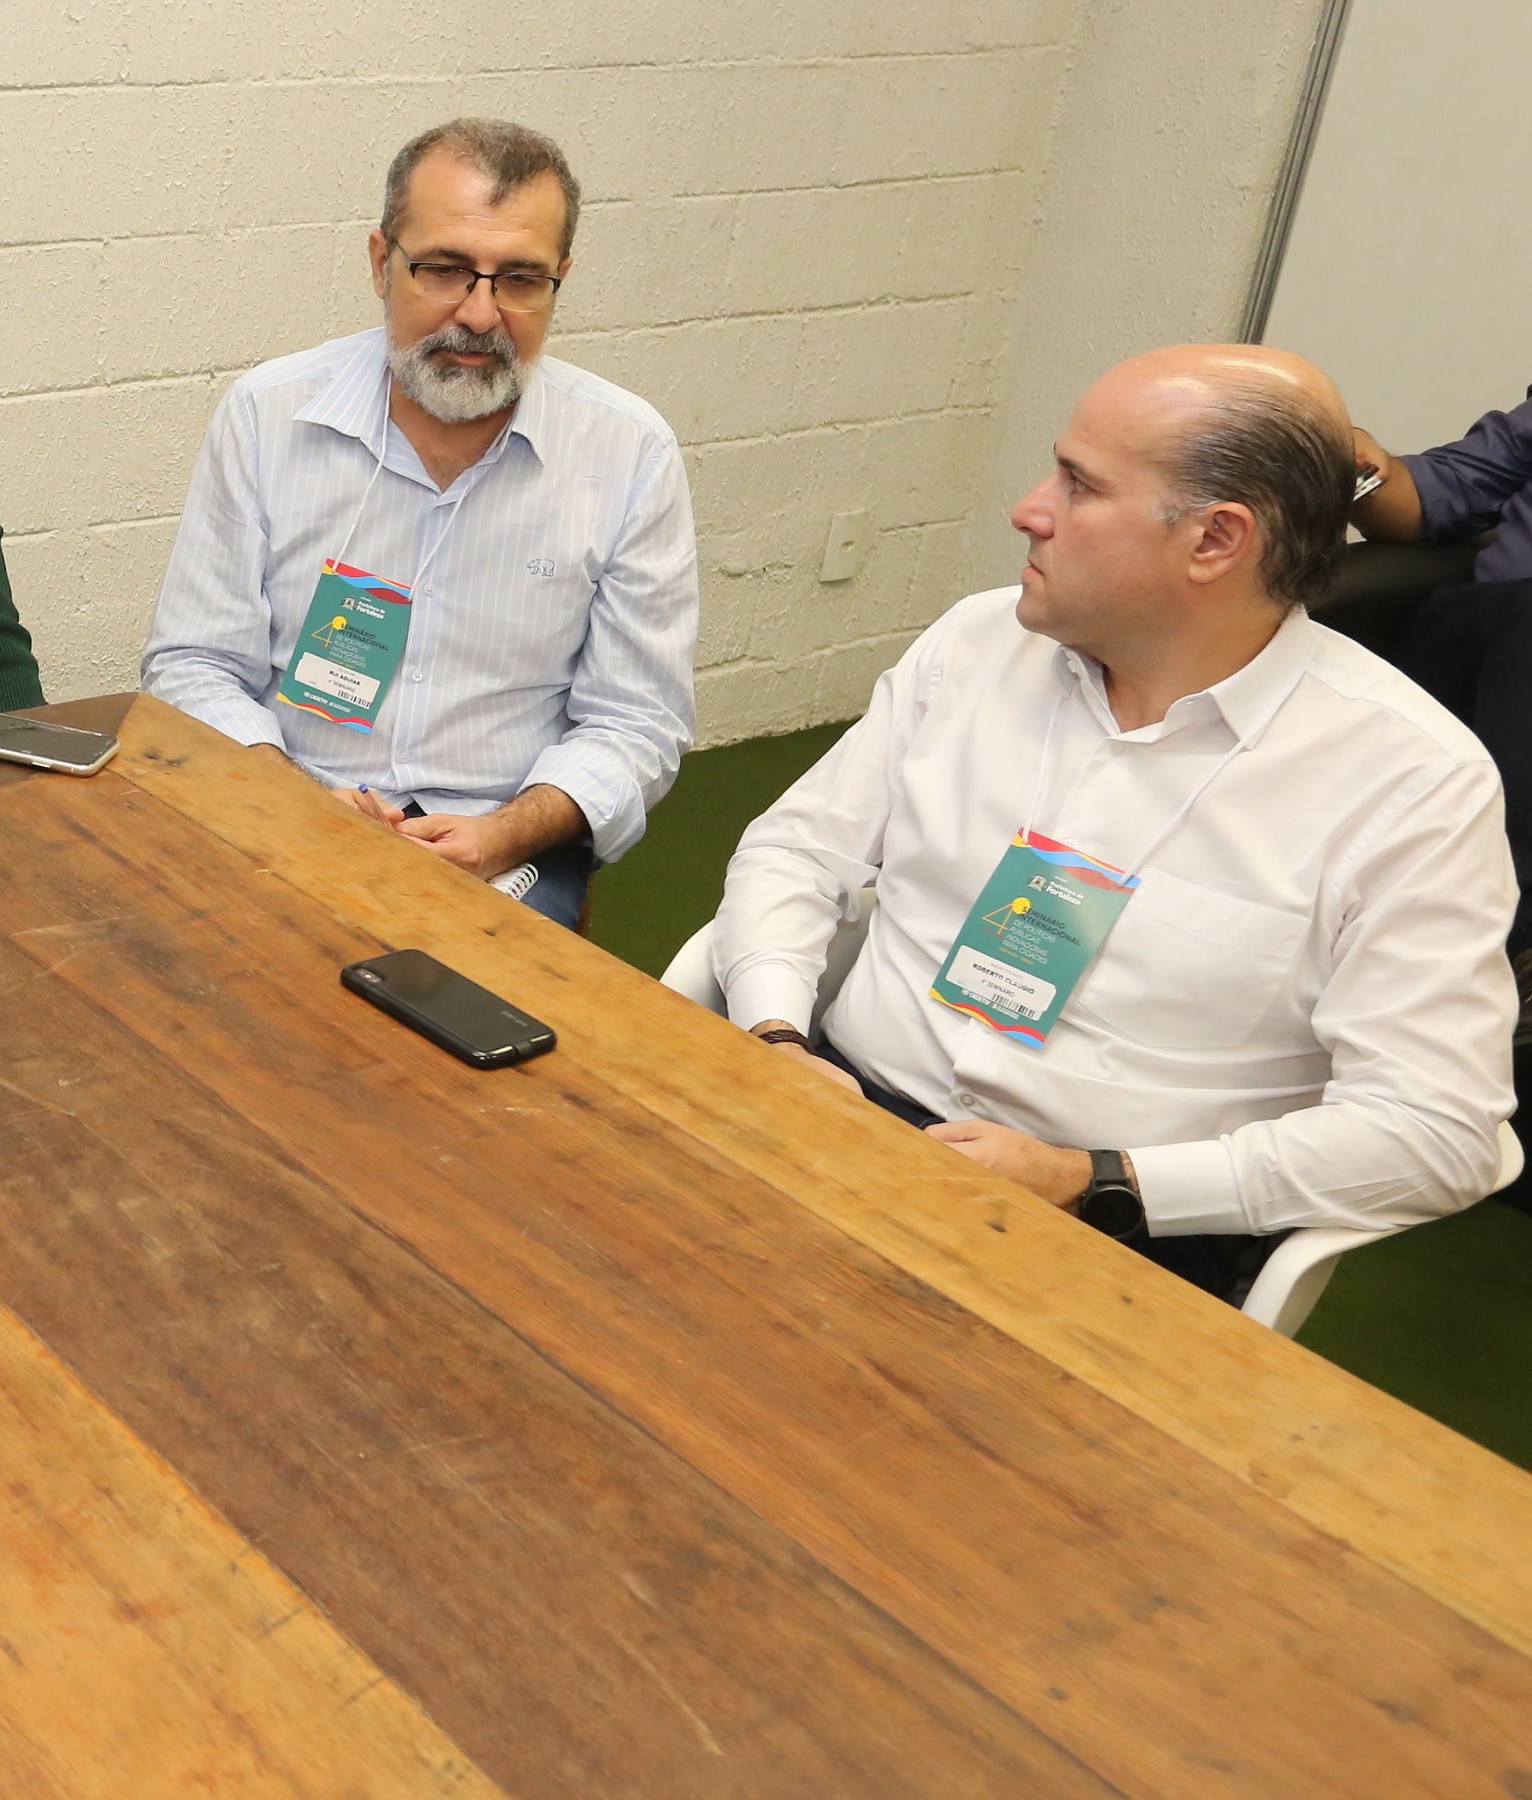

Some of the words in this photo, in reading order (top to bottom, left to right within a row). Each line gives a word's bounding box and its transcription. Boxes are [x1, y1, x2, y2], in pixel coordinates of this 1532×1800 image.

[356, 605, 384, 619] Fortaleza
[341, 623, 376, 639] SEMINÁRIO
[338, 629, 389, 651] INTERNACIONAL
[329, 670, 339, 678] RUI
[340, 675, 361, 686] AGUIAR
[1046, 886, 1081, 905] Fortaleza
[1022, 906, 1065, 929] SEMINÁRIO
[1018, 913, 1080, 945] INTERNACIONAL
[973, 964, 1004, 980] ROBERTO
[987, 981, 1015, 997] SEMINÁRIO
